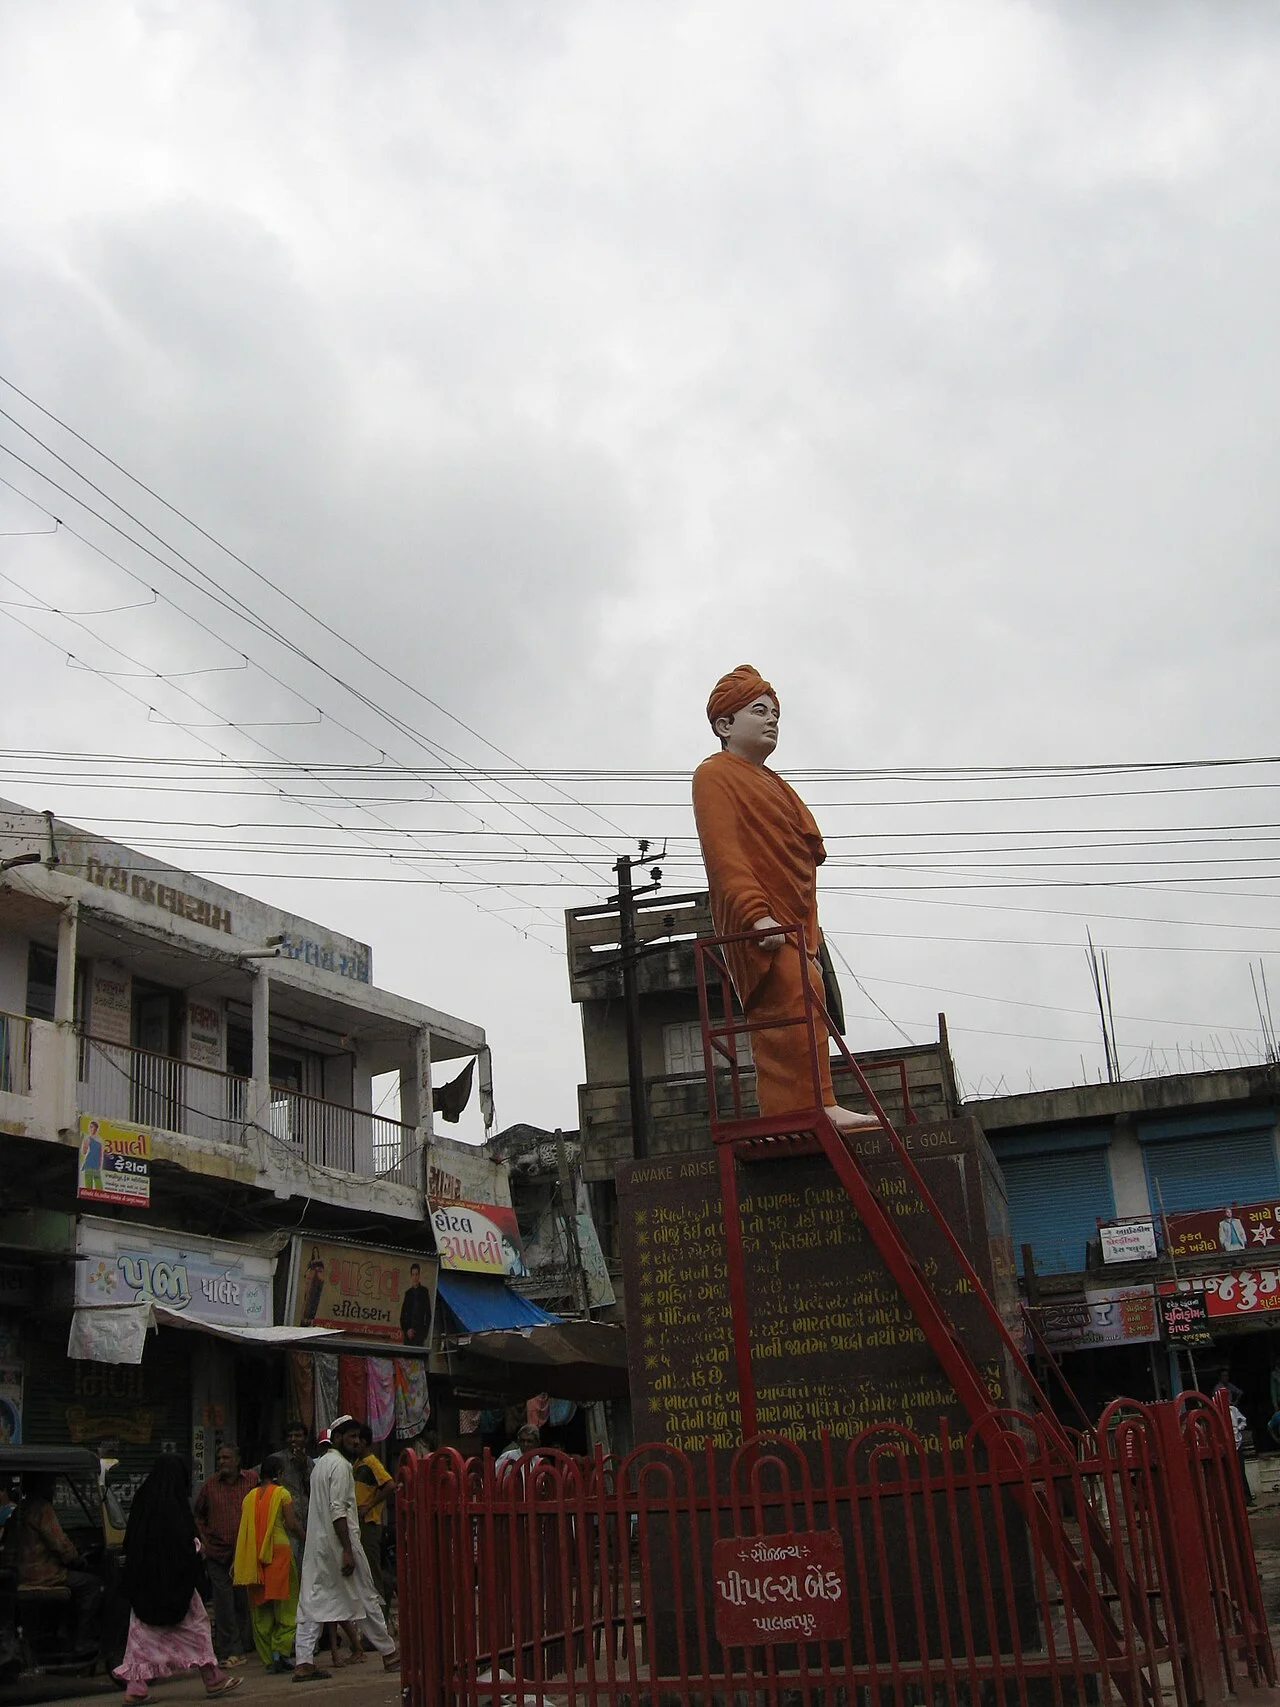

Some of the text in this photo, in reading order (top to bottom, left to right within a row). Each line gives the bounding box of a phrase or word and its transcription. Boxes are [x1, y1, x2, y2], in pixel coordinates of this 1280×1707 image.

[630, 1166, 673, 1184] AWAKE
[679, 1160, 716, 1178] ARISE
[919, 1130, 957, 1147] GOAL
[434, 1206, 473, 1233] હોટલ
[1249, 1207, 1272, 1222] સાથે
[750, 1542, 802, 1562] સૌજન્ય
[716, 1569, 802, 1606] પીપલ્સ
[752, 1613, 817, 1636] પાલનપુર
